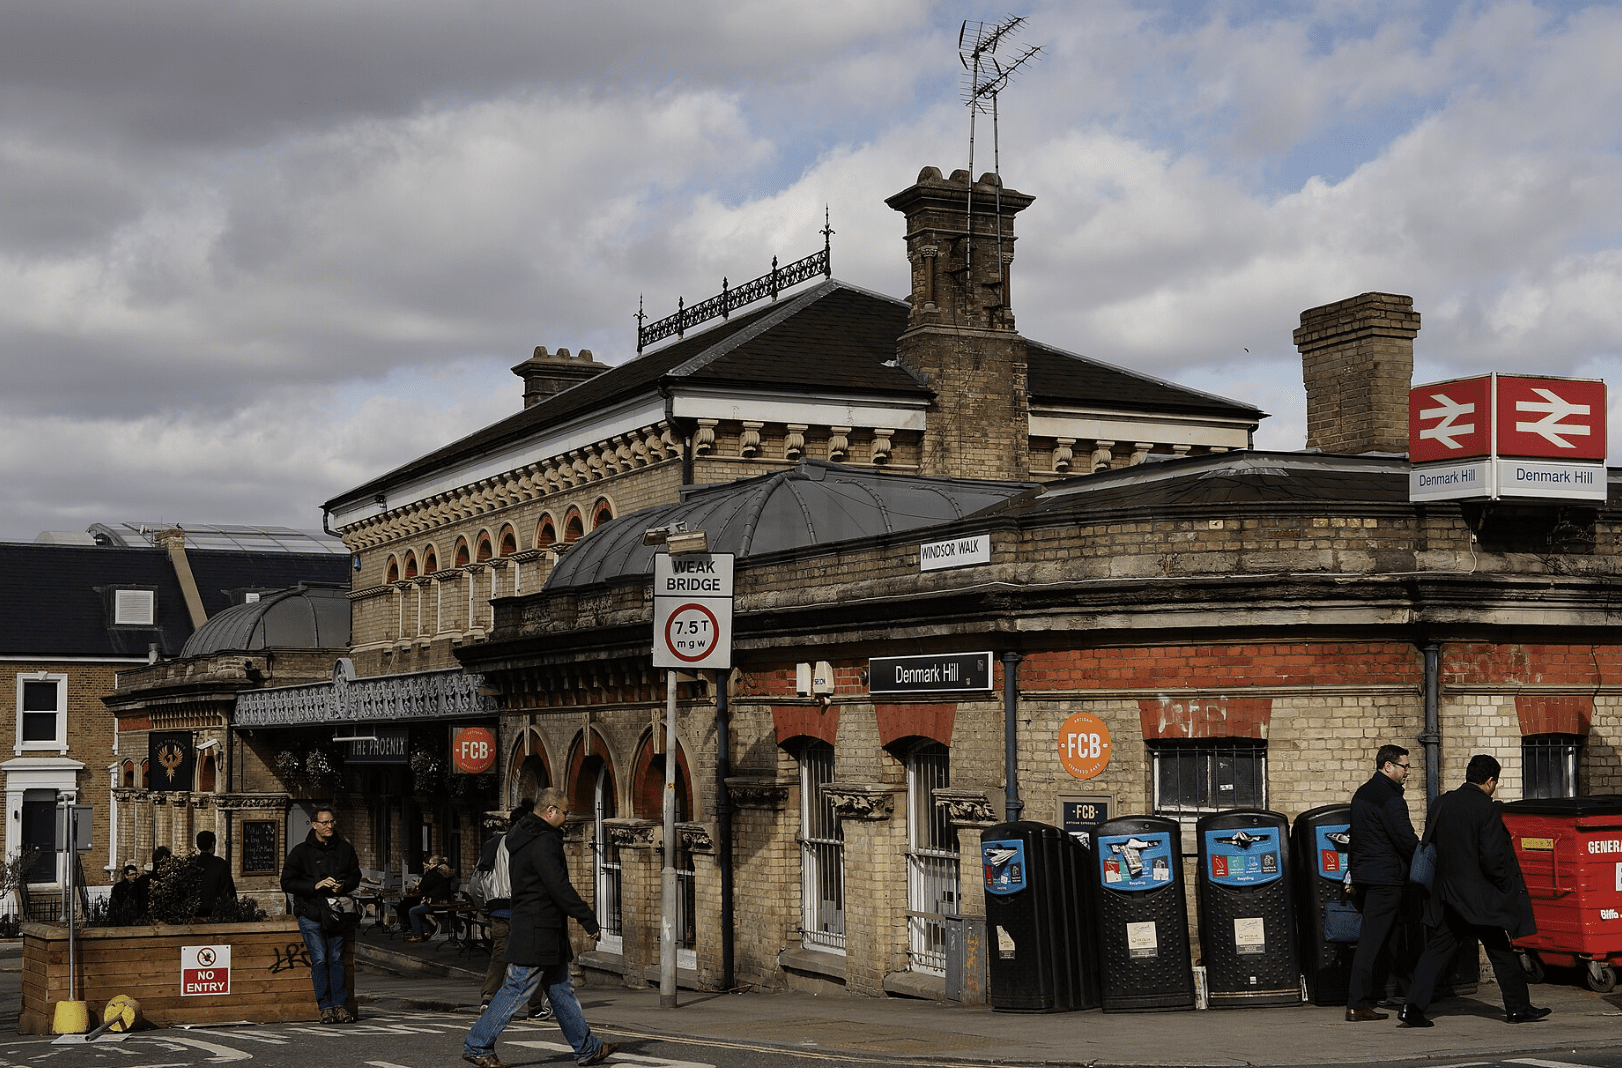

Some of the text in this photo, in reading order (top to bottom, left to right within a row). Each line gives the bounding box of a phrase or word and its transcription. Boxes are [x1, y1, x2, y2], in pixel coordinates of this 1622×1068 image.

[1419, 469, 1476, 487] Denmark Hill
[1516, 468, 1593, 484] Denmark Hill
[921, 539, 979, 560] WINDSOR WALK
[672, 560, 716, 574] WEAK
[666, 577, 721, 591] BRIDGE
[895, 662, 959, 684] Denmark Hill
[352, 736, 405, 756] THE PHOENIX
[461, 741, 489, 760] FCB
[1067, 732, 1102, 759] FCB
[1076, 804, 1095, 820] FCB
[1600, 908, 1619, 920] Biffa
[197, 970, 214, 981] NO
[186, 981, 226, 993] ENTRY
